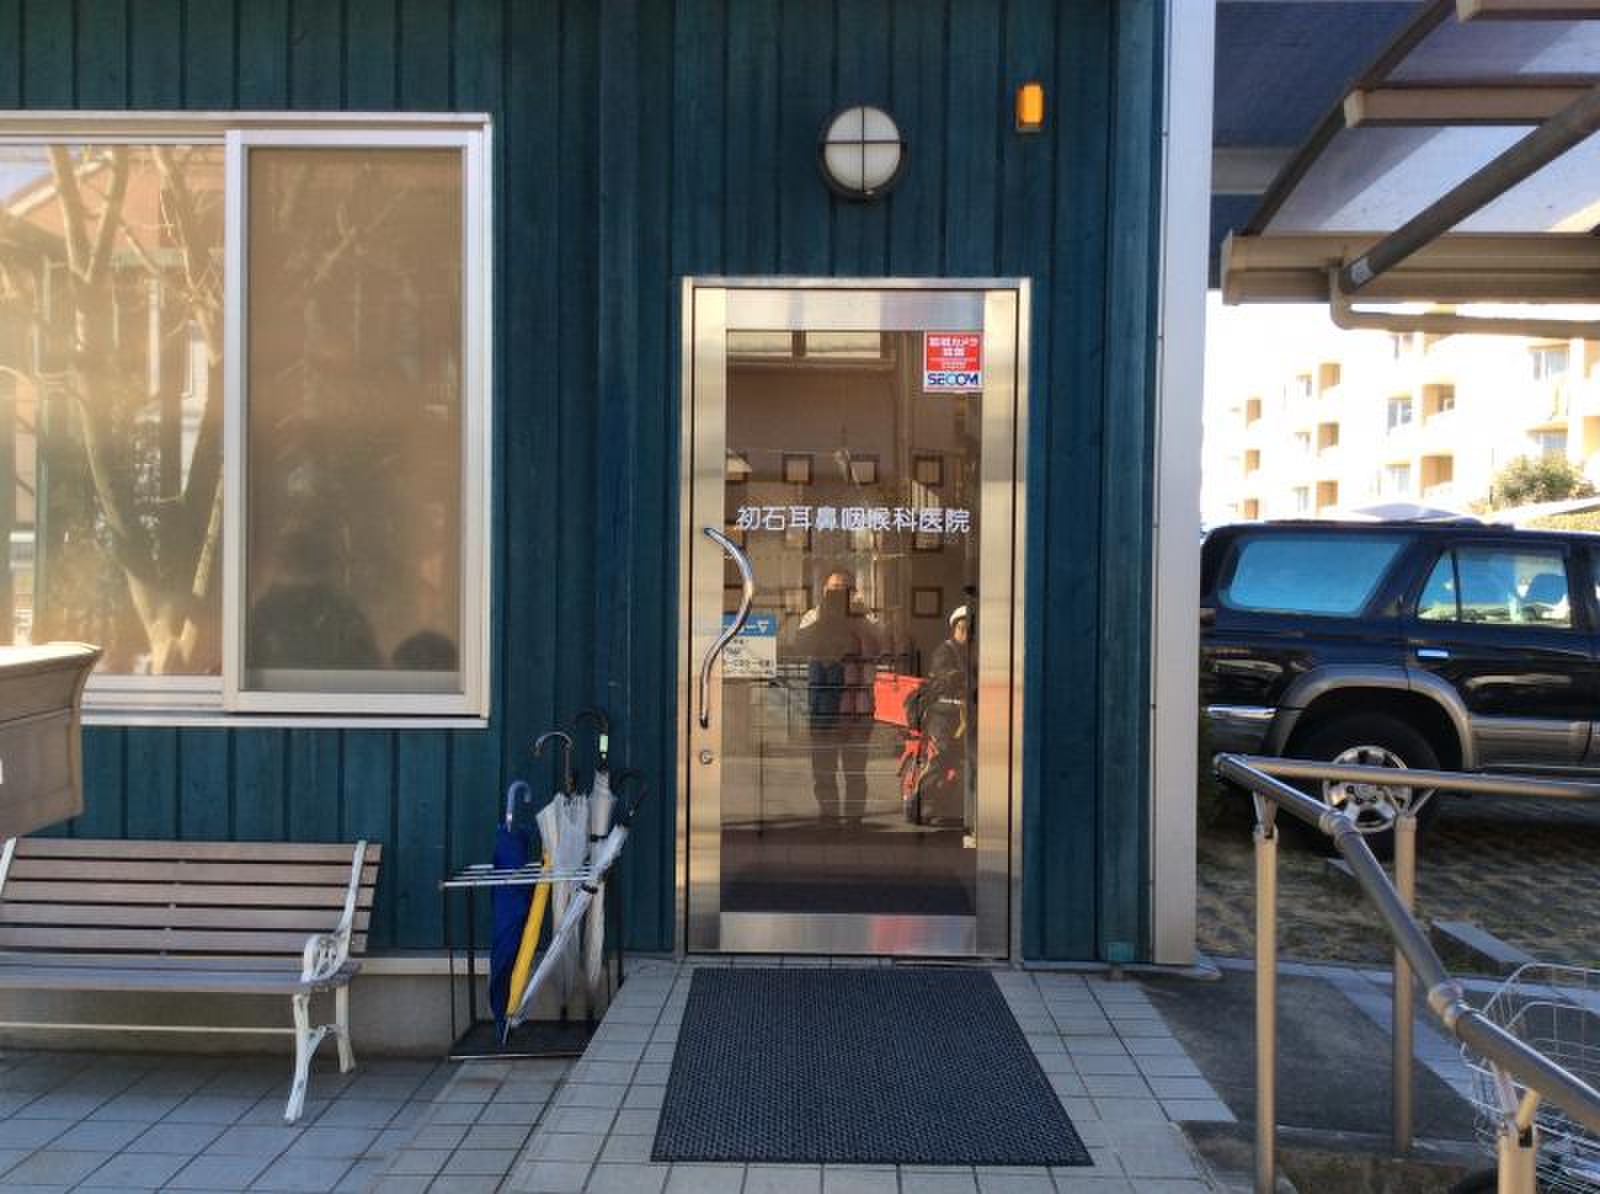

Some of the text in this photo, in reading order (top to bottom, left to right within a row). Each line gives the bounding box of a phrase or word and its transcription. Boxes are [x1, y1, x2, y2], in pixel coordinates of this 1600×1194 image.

[928, 373, 978, 385] SECOM
[736, 506, 970, 533] 初石耳鼻咽喉科医院
